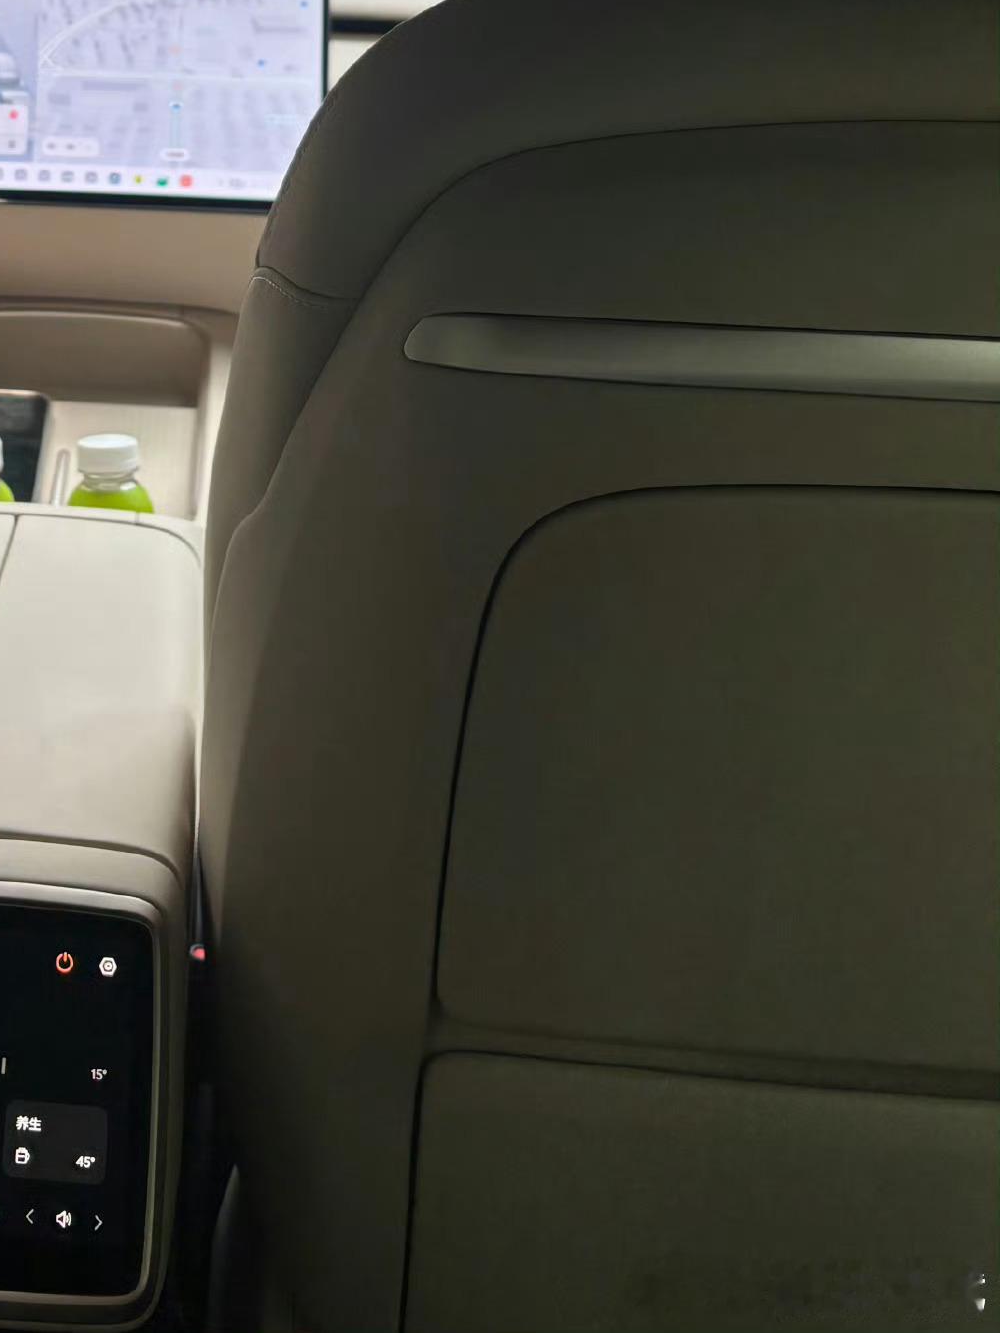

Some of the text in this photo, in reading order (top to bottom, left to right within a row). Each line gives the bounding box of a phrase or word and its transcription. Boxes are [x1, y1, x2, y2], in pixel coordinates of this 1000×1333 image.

[90, 1068, 108, 1080] 15°
[15, 1115, 42, 1132] 养生
[75, 1155, 96, 1168] 45°
